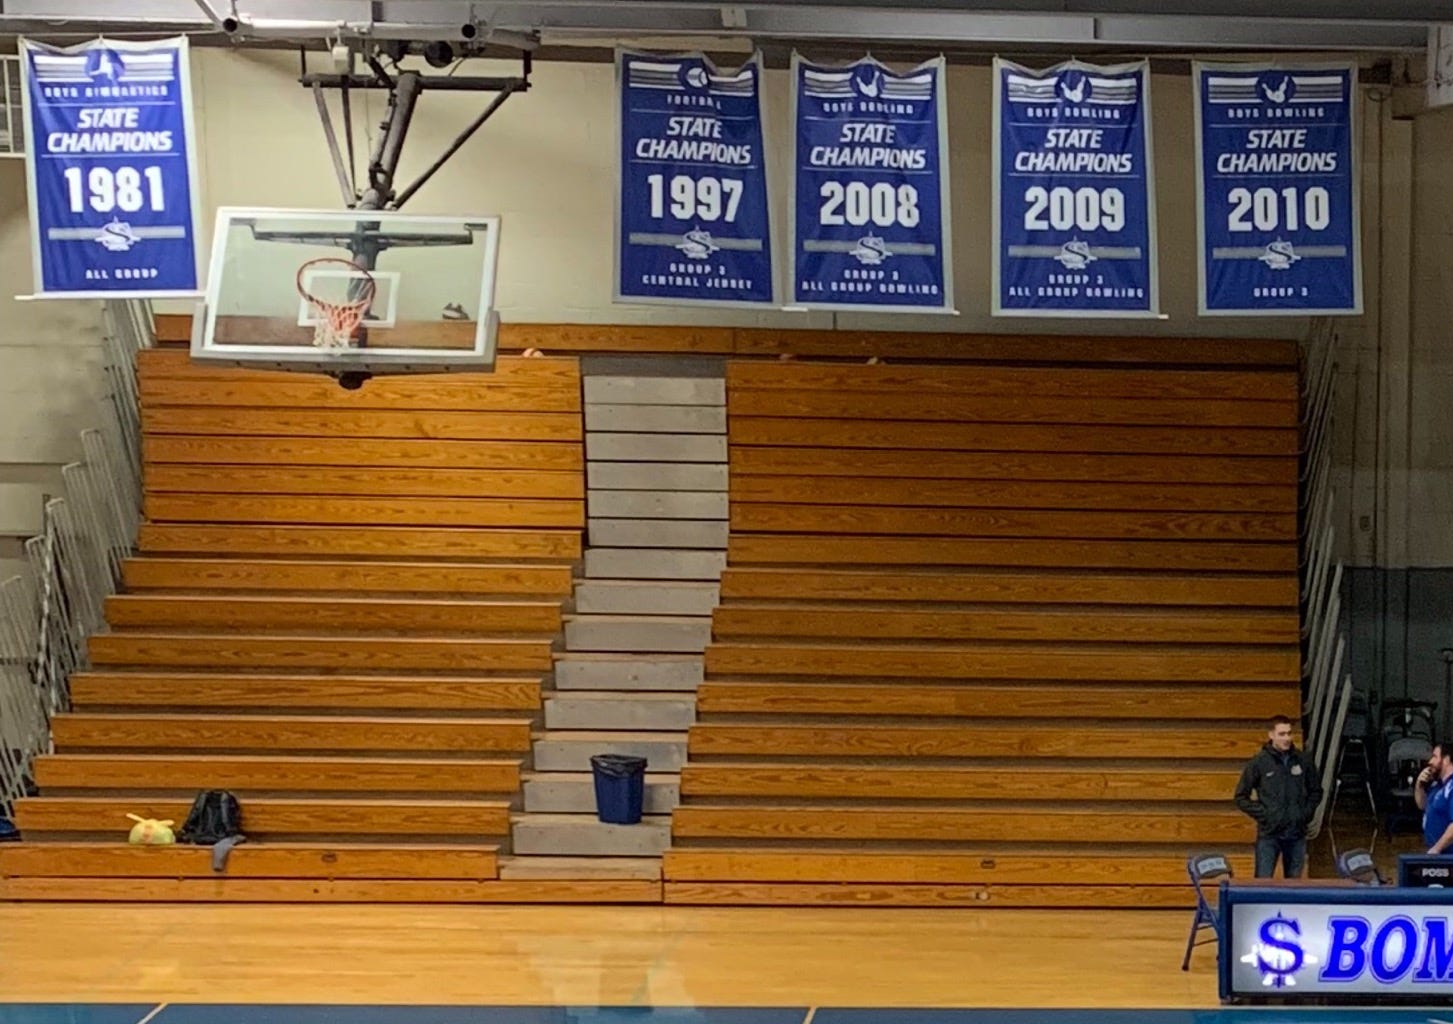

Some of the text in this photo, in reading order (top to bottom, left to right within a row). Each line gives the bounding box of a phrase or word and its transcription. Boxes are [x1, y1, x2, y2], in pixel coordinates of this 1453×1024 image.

[823, 103, 853, 112] BOYS
[1027, 108, 1120, 119] BOYS BOWLING
[1228, 108, 1324, 117] BOYS BOWLING
[78, 108, 139, 128] STATE
[667, 117, 722, 138] STATE
[47, 131, 173, 152] CHAMPIONS
[840, 123, 896, 143] STATE
[1045, 129, 1103, 149] STATE
[1246, 129, 1307, 149] STATE
[636, 139, 751, 164] CHAMPIONS
[810, 147, 926, 169] CHAMPIONS
[1015, 152, 1132, 173] CHAMPIONS
[1217, 153, 1337, 173] CHAMPIONS
[64, 166, 164, 212] 1981
[648, 175, 743, 222] 1997
[820, 181, 920, 227] 2008
[1024, 186, 1125, 231] 2009
[1228, 187, 1329, 231] 2010
[86, 269, 158, 279] ALL GROUP
[670, 263, 711, 274] GROUP
[844, 270, 884, 279] GROUP
[642, 275, 752, 288] CENTRAL JERSEY
[802, 281, 938, 294] ALL GROUP BOWLING
[1049, 275, 1089, 284] GROUP
[1009, 287, 1143, 297] ALL GROUP BOWLING
[1254, 288, 1294, 297] GROUP
[1422, 868, 1449, 877] POSS
